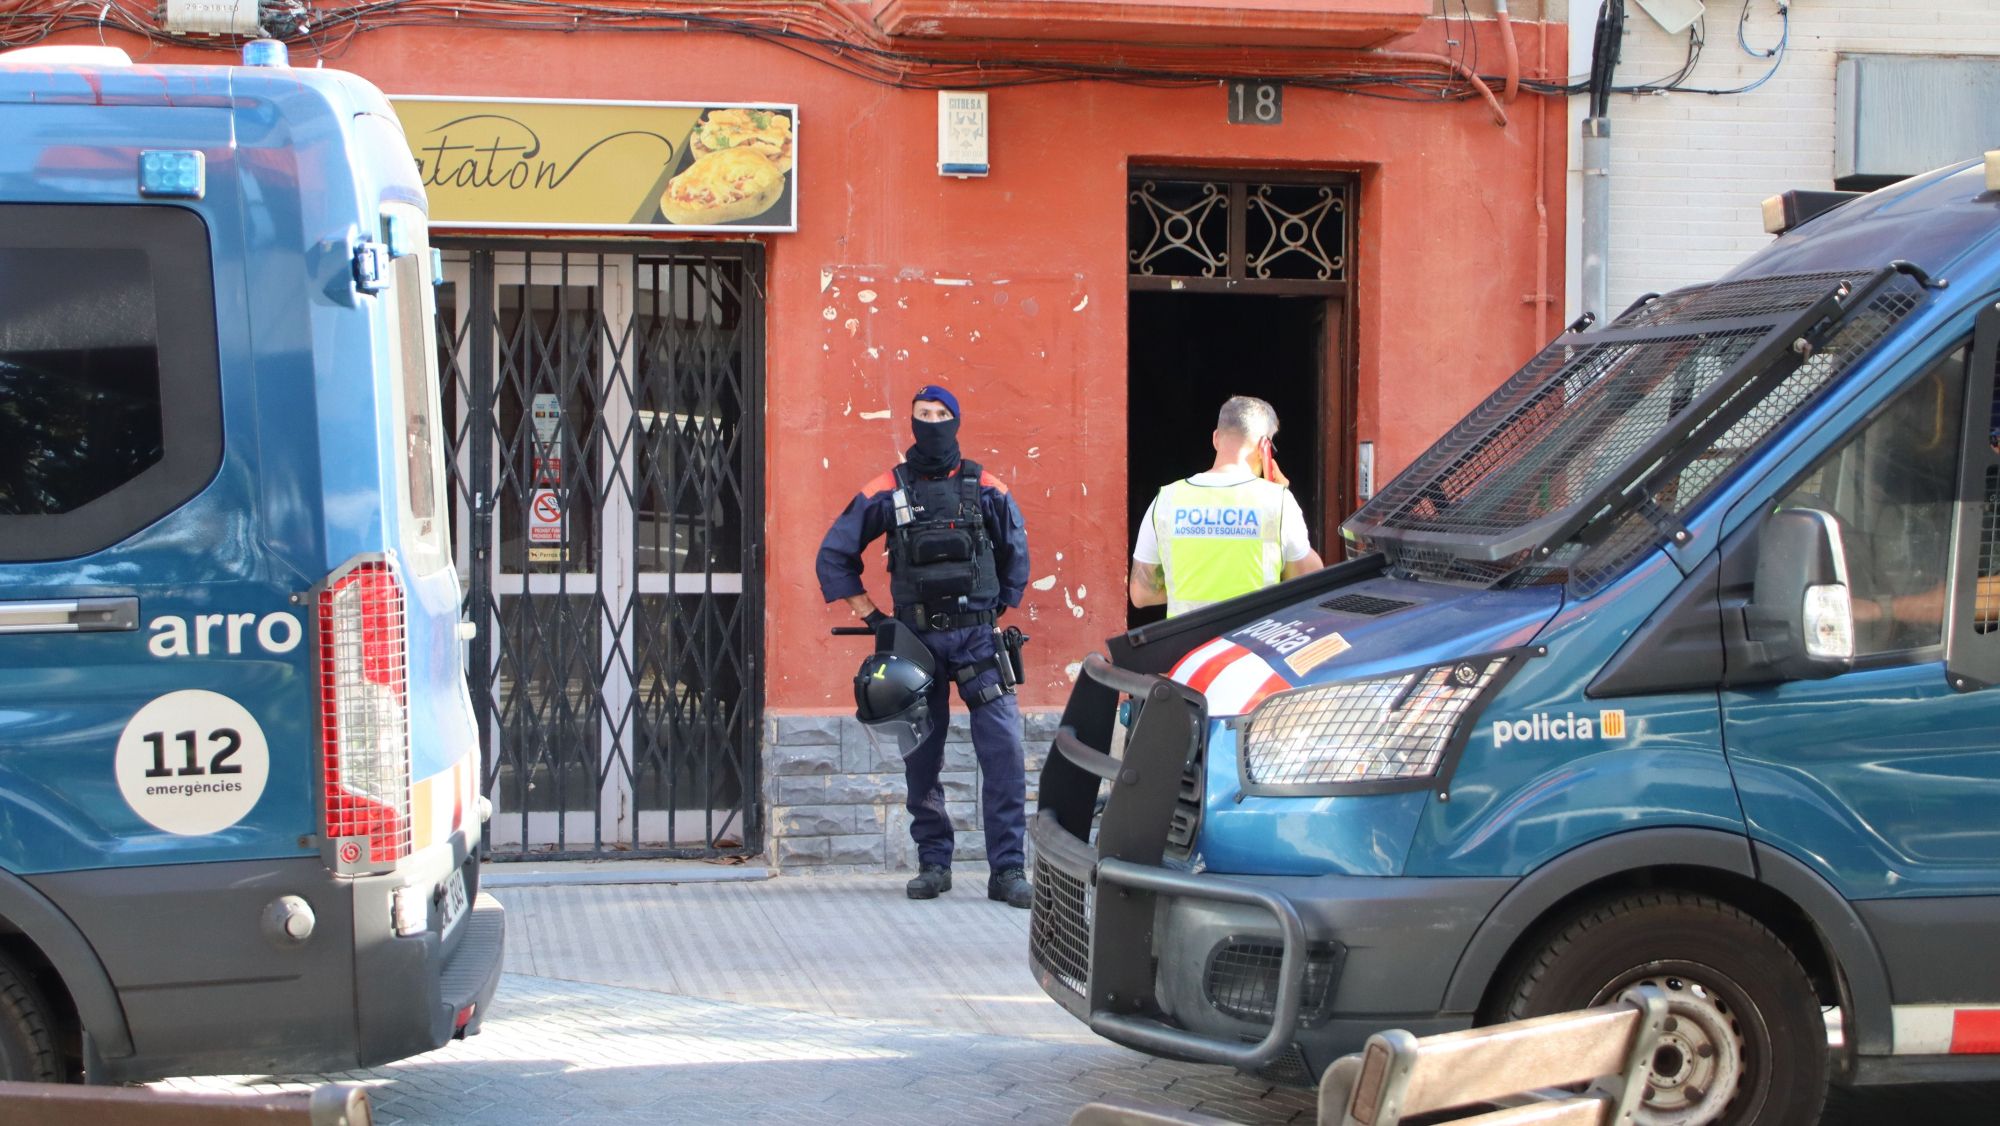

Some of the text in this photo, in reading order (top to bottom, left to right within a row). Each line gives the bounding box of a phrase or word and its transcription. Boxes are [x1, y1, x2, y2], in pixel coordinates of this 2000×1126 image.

[1235, 84, 1276, 121] 18
[1174, 508, 1259, 526] POLICIA
[149, 611, 303, 657] arro
[1231, 619, 1316, 655] policia
[1493, 711, 1594, 748] policia
[143, 727, 243, 778] 112
[146, 780, 242, 797] emergències
